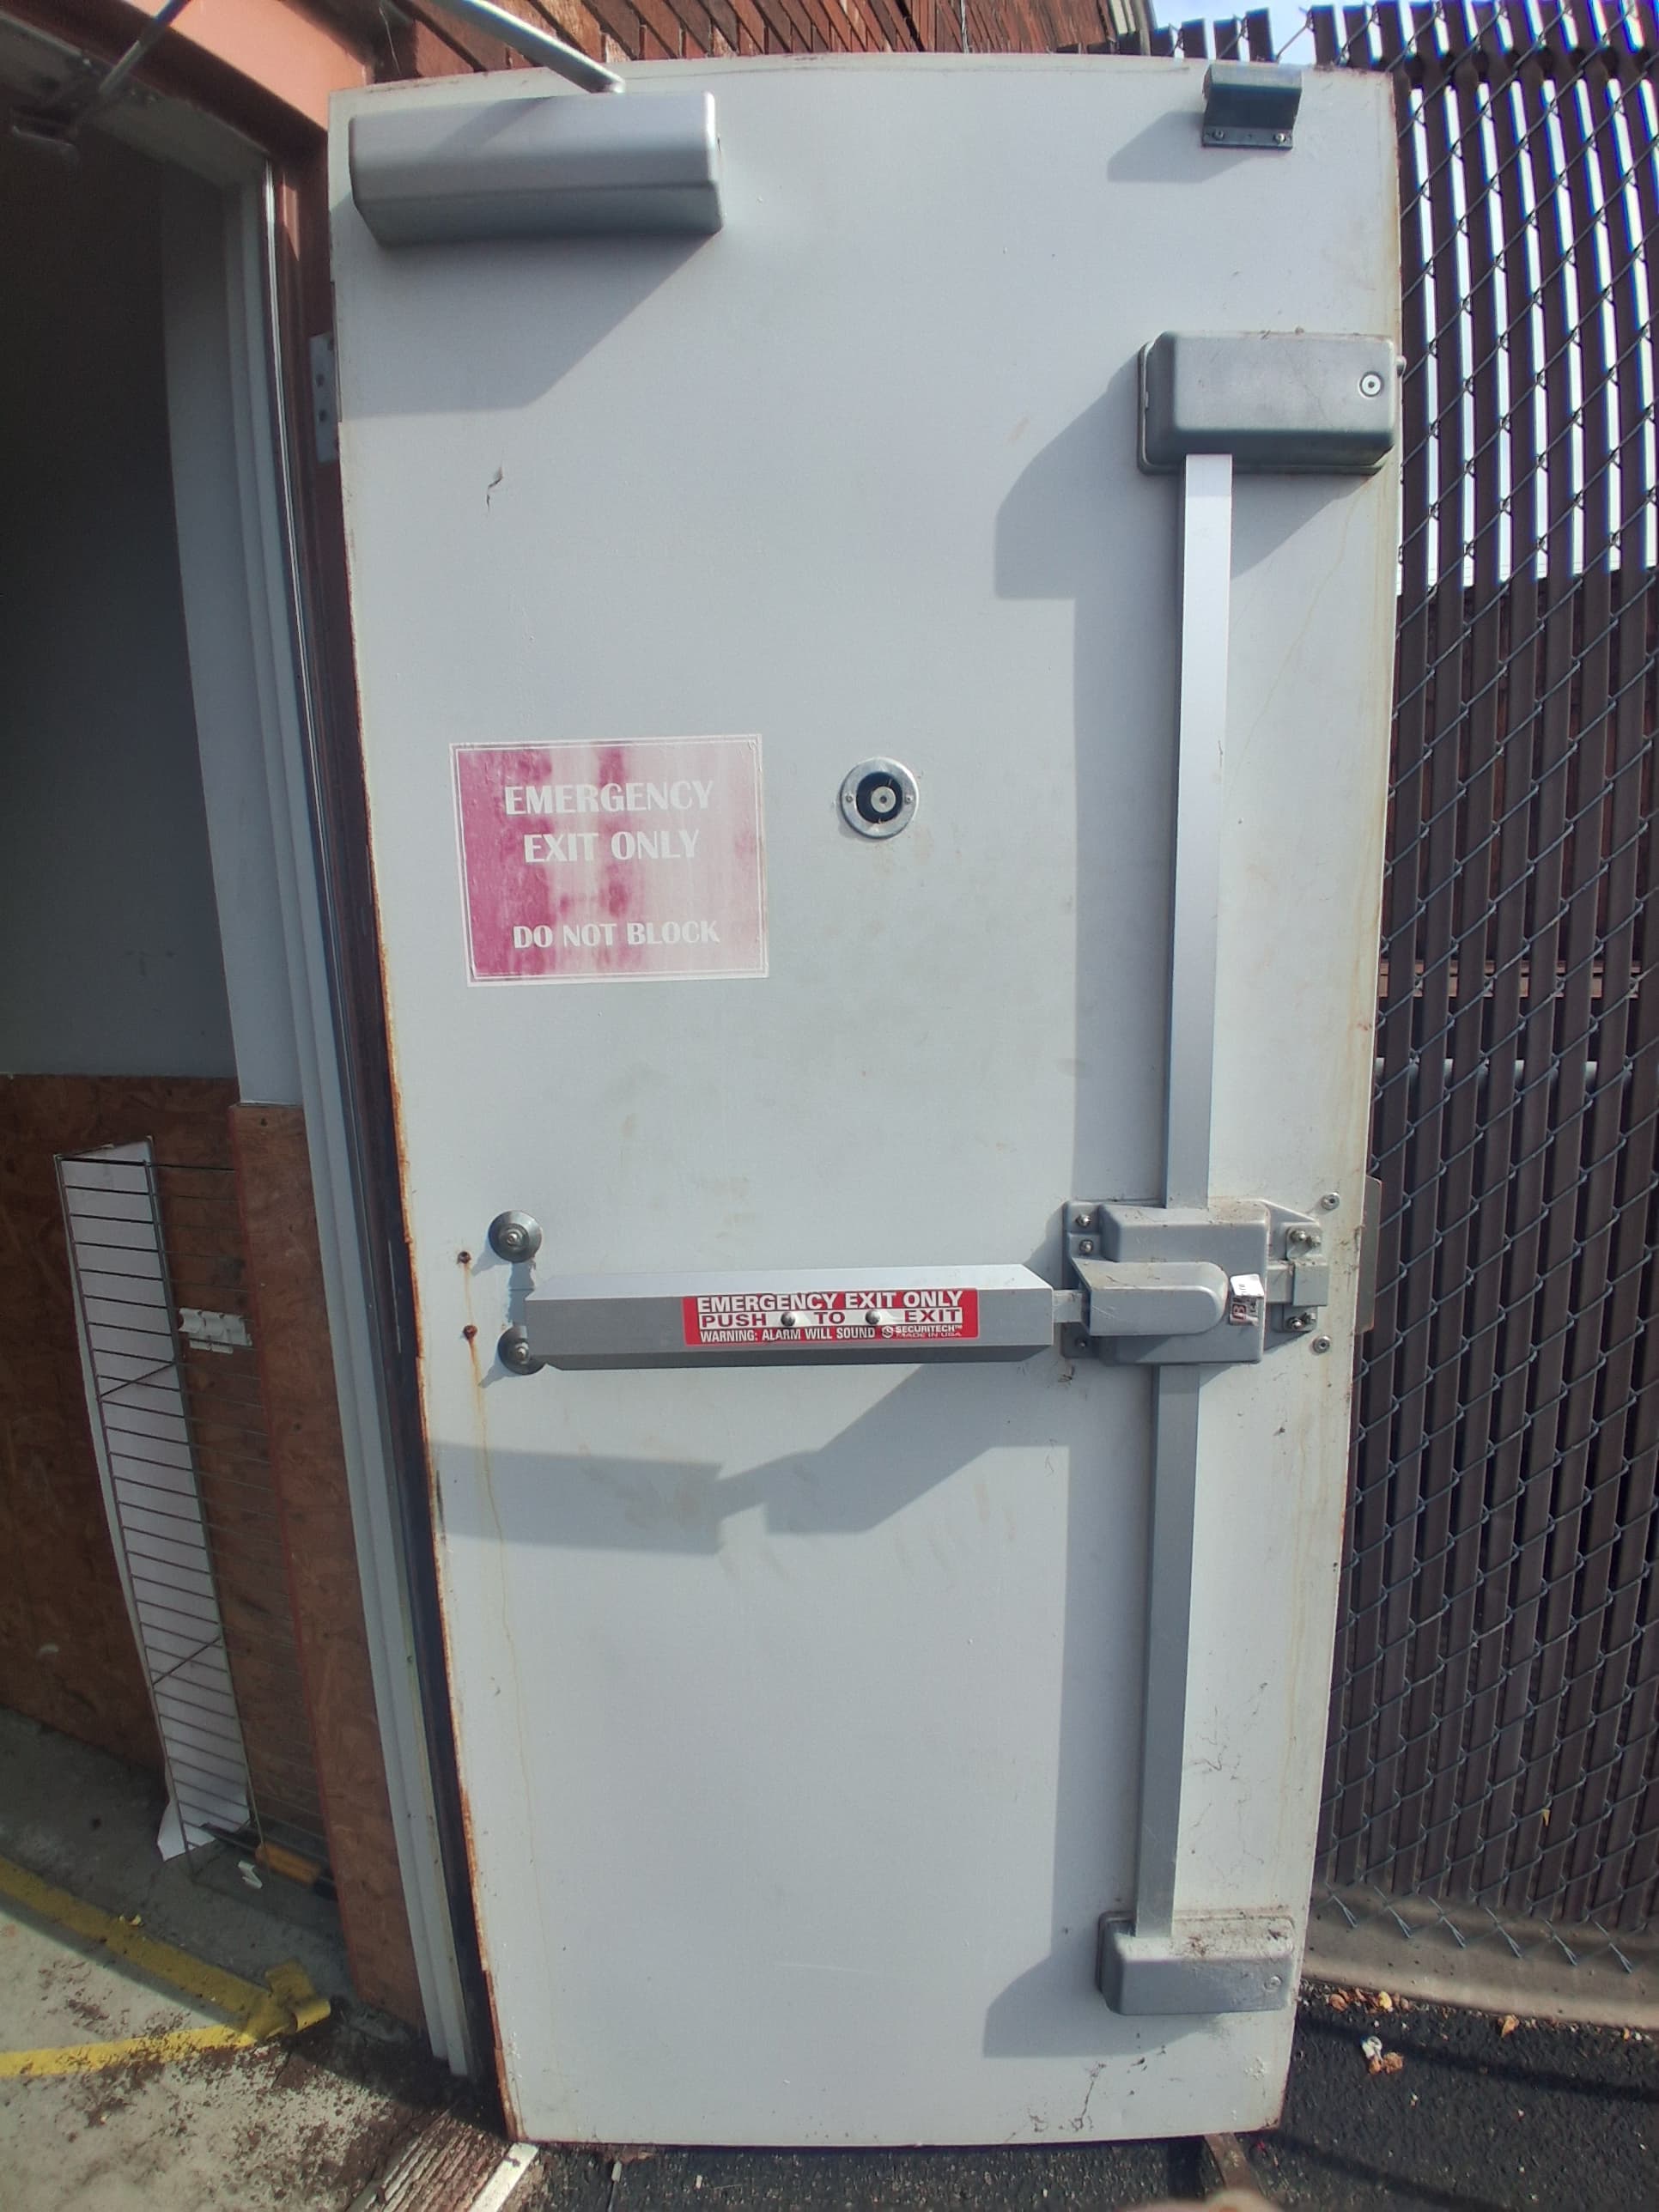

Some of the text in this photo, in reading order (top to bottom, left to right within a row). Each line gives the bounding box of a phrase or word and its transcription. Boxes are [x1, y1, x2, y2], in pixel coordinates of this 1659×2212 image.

[504, 781, 714, 815] EMERGENCY
[524, 830, 699, 863] EXIT ONLY
[514, 921, 720, 948] DO NOT BLOCK
[696, 1290, 963, 1313] EMERGENCY EXIT ONLY
[702, 1309, 961, 1328] PUSH TO EXIT
[700, 1325, 875, 1342] WARNING: ALARM WILL SOUND
